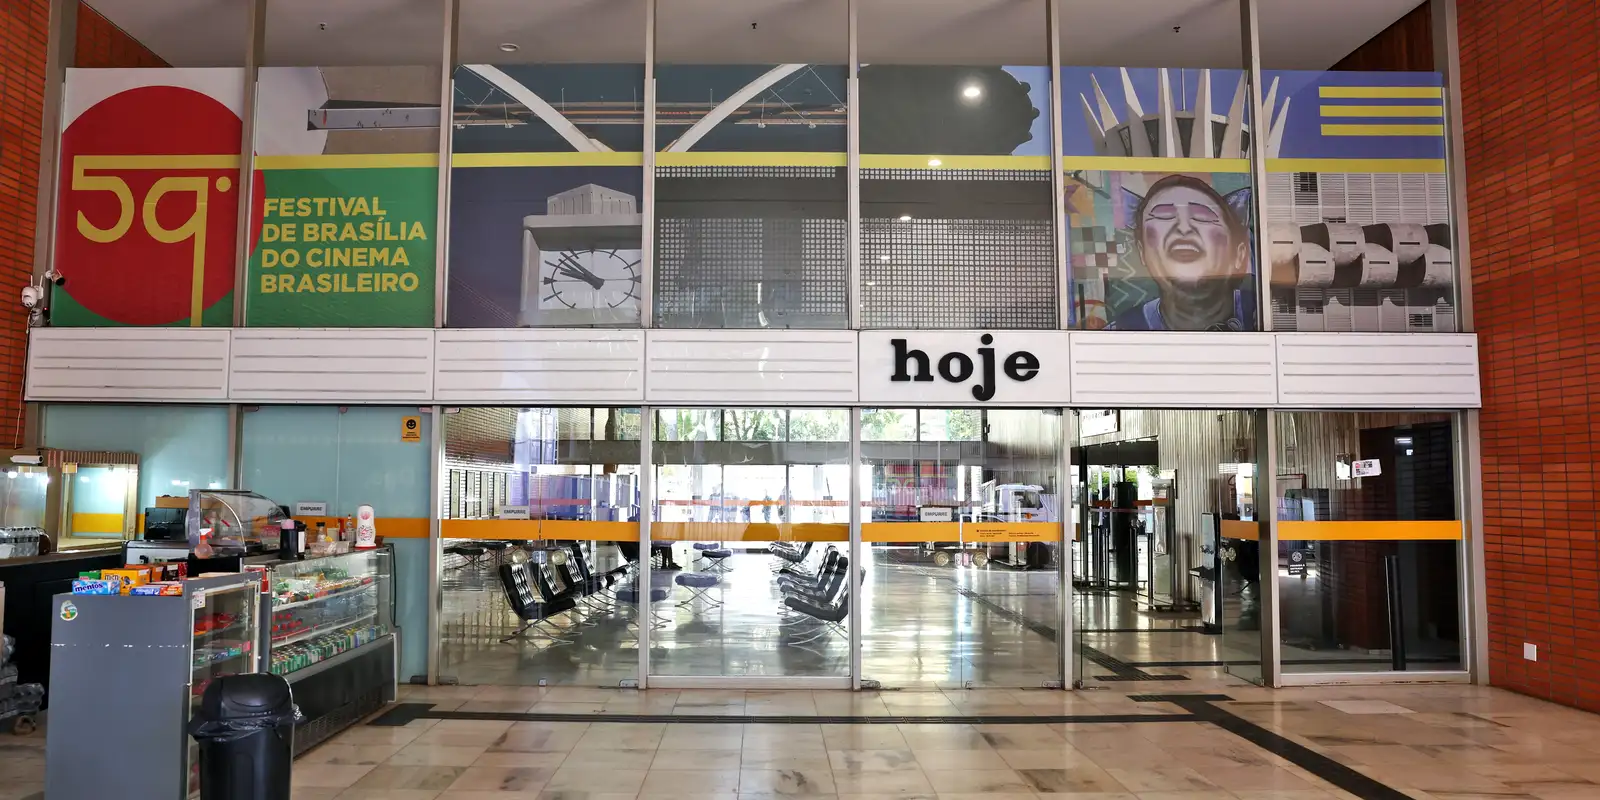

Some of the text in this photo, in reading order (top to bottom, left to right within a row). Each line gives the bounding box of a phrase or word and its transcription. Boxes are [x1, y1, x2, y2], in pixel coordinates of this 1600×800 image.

[263, 197, 387, 217] FESTIVAL
[262, 217, 427, 242] DE BRASÍLIA
[261, 247, 409, 268] DO CINEMA
[260, 272, 419, 293] BRASILEIRO
[891, 333, 1040, 401] hoje
[75, 583, 104, 592] mentos
